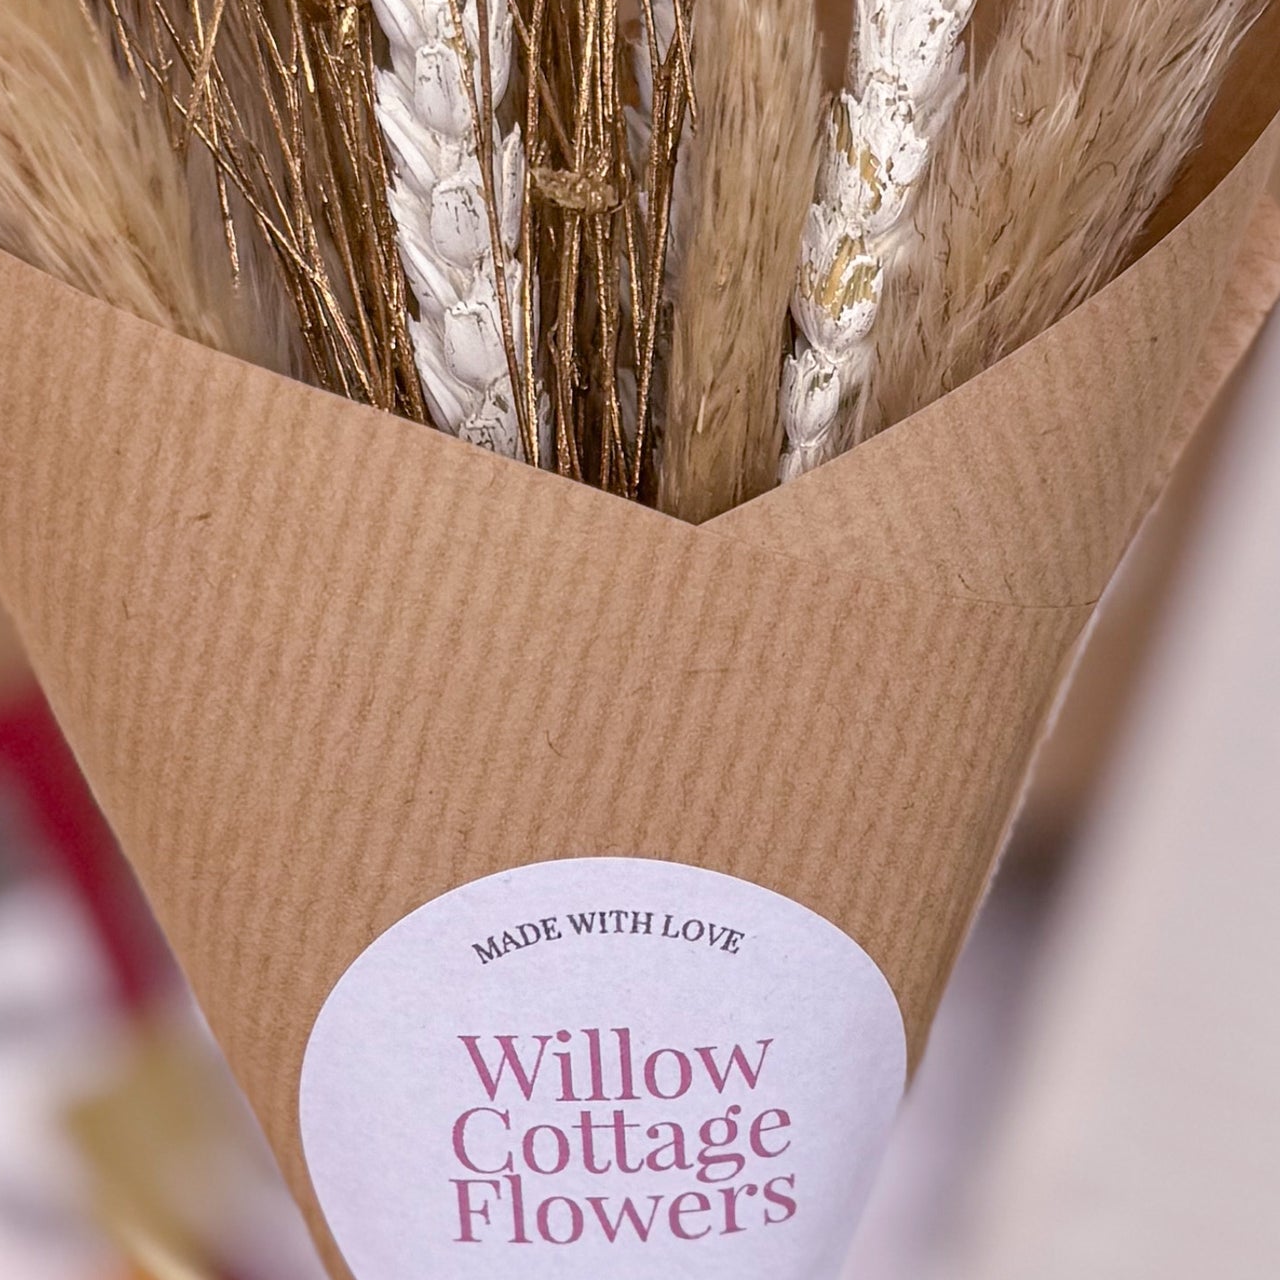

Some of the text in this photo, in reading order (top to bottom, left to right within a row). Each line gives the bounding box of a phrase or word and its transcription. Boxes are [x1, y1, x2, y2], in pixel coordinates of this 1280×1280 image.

[471, 909, 746, 966] MADE WITH LOVE
[457, 1027, 775, 1103] Willow
[451, 1104, 793, 1184] Cottage
[449, 1172, 798, 1245] Flowers
